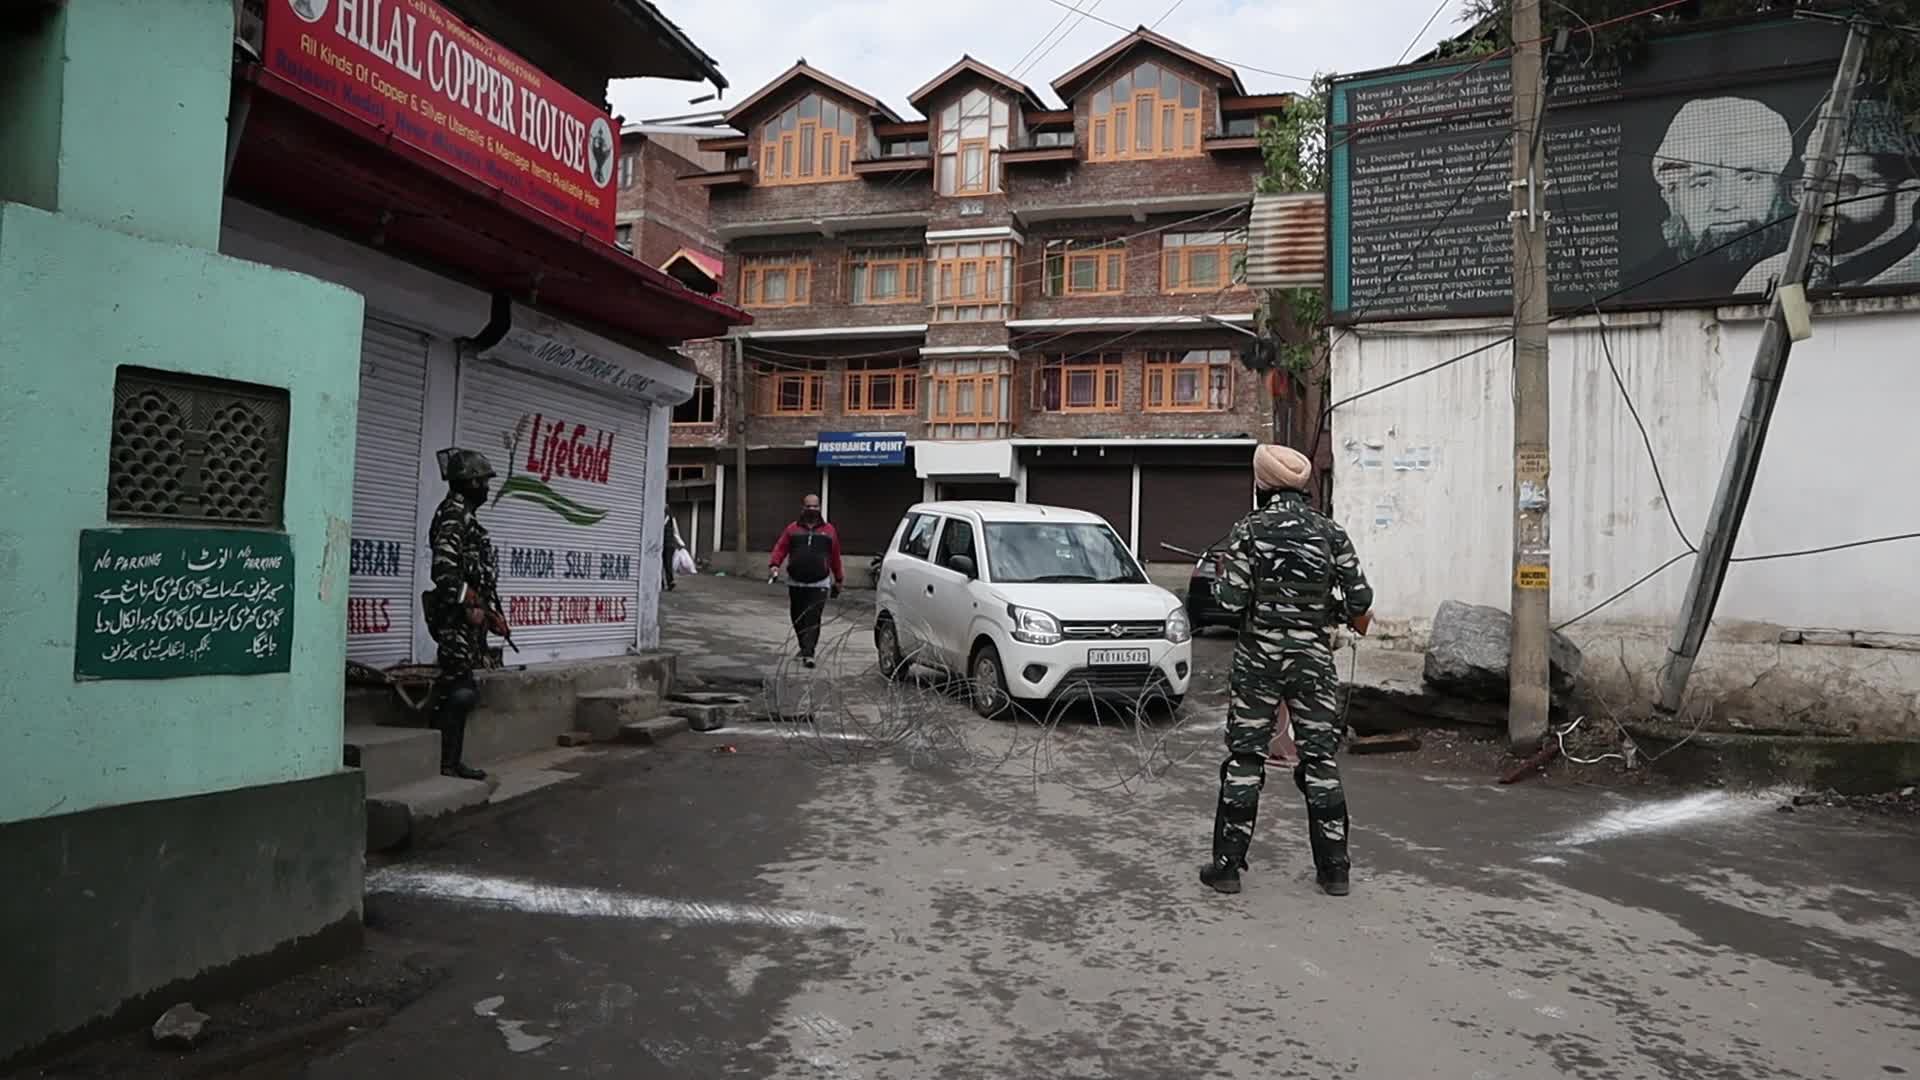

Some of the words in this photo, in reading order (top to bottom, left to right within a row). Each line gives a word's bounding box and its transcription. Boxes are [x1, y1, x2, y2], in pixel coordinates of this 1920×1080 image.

[301, 34, 318, 57] All
[320, 43, 354, 76] Kinds
[356, 63, 369, 84] Of
[371, 73, 409, 104] Copper
[410, 95, 418, 112] &
[335, 0, 422, 80] HILAL
[428, 30, 516, 135] COPPER
[520, 86, 587, 174] HOUSE
[1356, 102, 1376, 113] Dec.
[1370, 151, 1415, 163] December
[1372, 242, 1402, 252] March
[526, 413, 616, 486] LifeGold
[819, 441, 871, 452] INSURANCE
[874, 441, 903, 451] POINT
[113, 552, 162, 571] PARKING
[351, 538, 401, 576] BRAN
[510, 547, 554, 578] MAIDA
[600, 553, 631, 580] BRAN
[510, 596, 552, 625] ROLLER
[557, 596, 590, 624] FLOUR
[595, 596, 627, 622] MILLS
